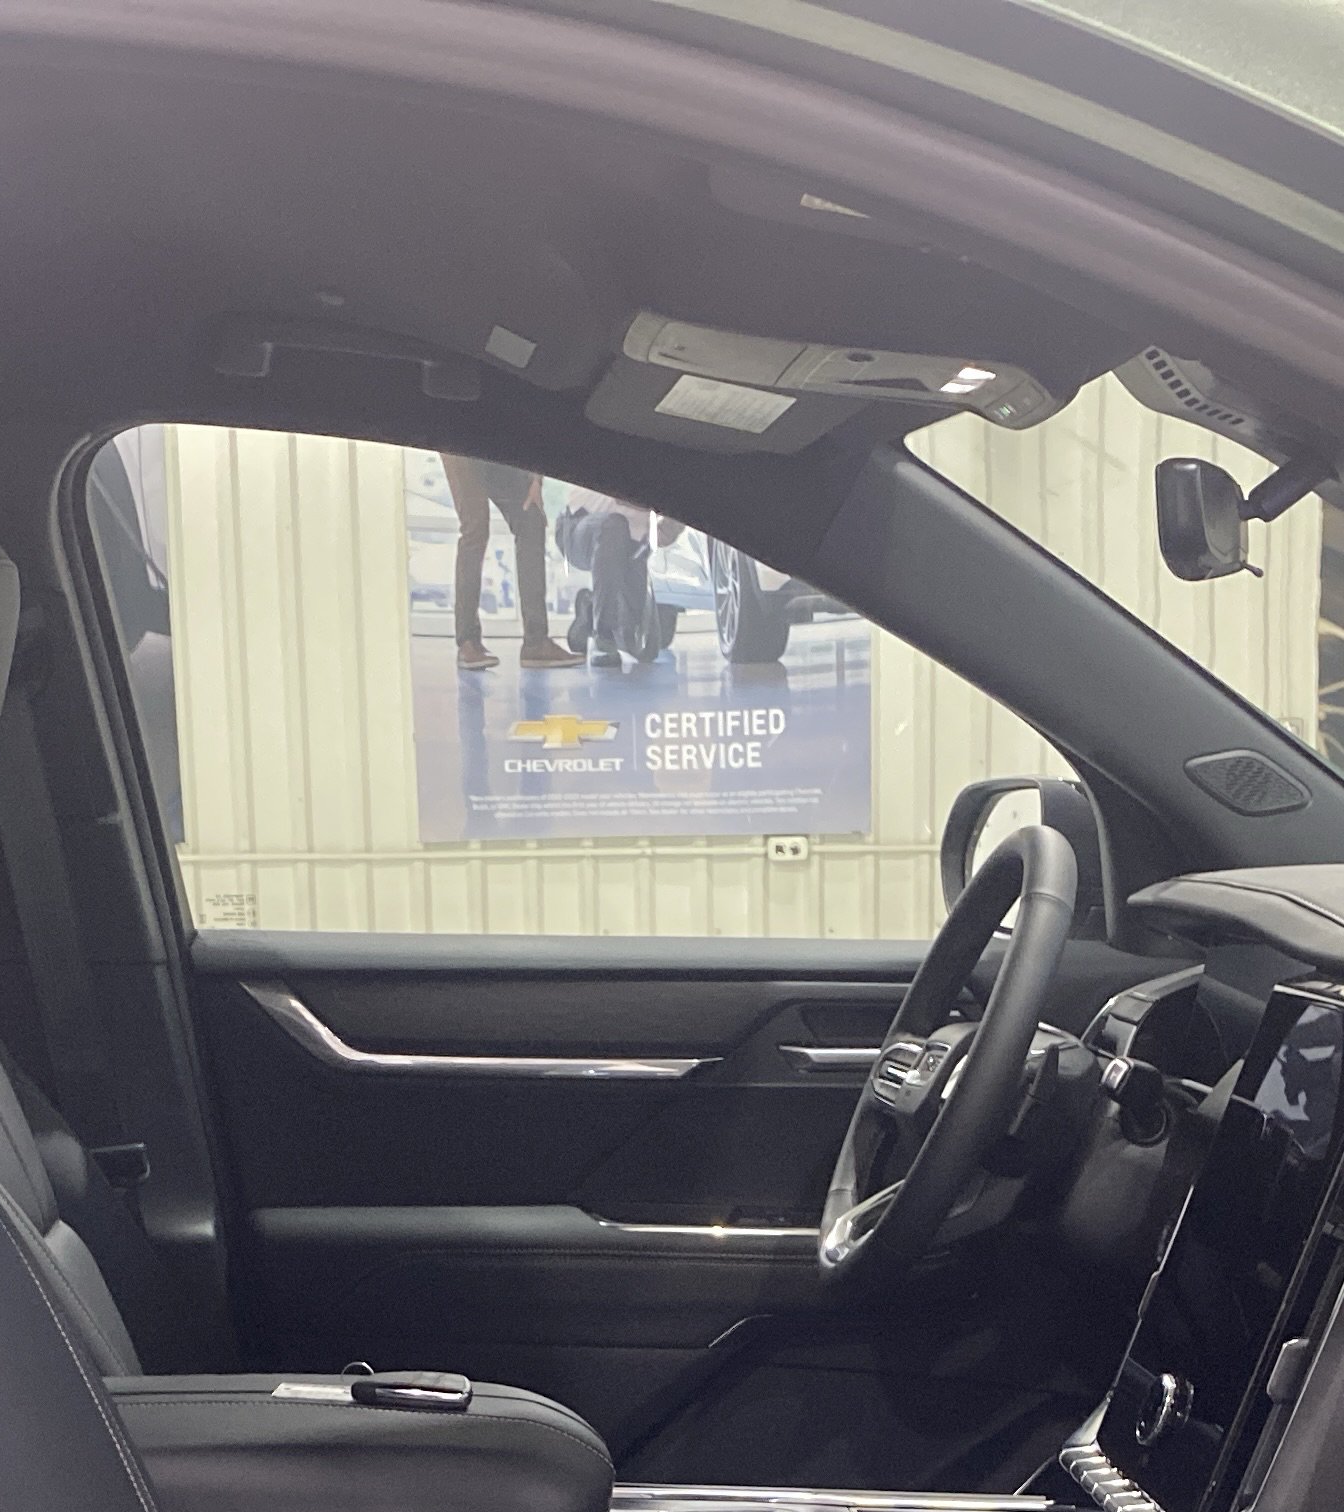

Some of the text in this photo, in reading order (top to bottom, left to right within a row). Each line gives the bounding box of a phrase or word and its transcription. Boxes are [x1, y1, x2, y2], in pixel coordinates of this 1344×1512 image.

[645, 708, 787, 739] CERTIFIED
[504, 758, 625, 773] CHEVROLET
[645, 741, 763, 771] SERVICE
